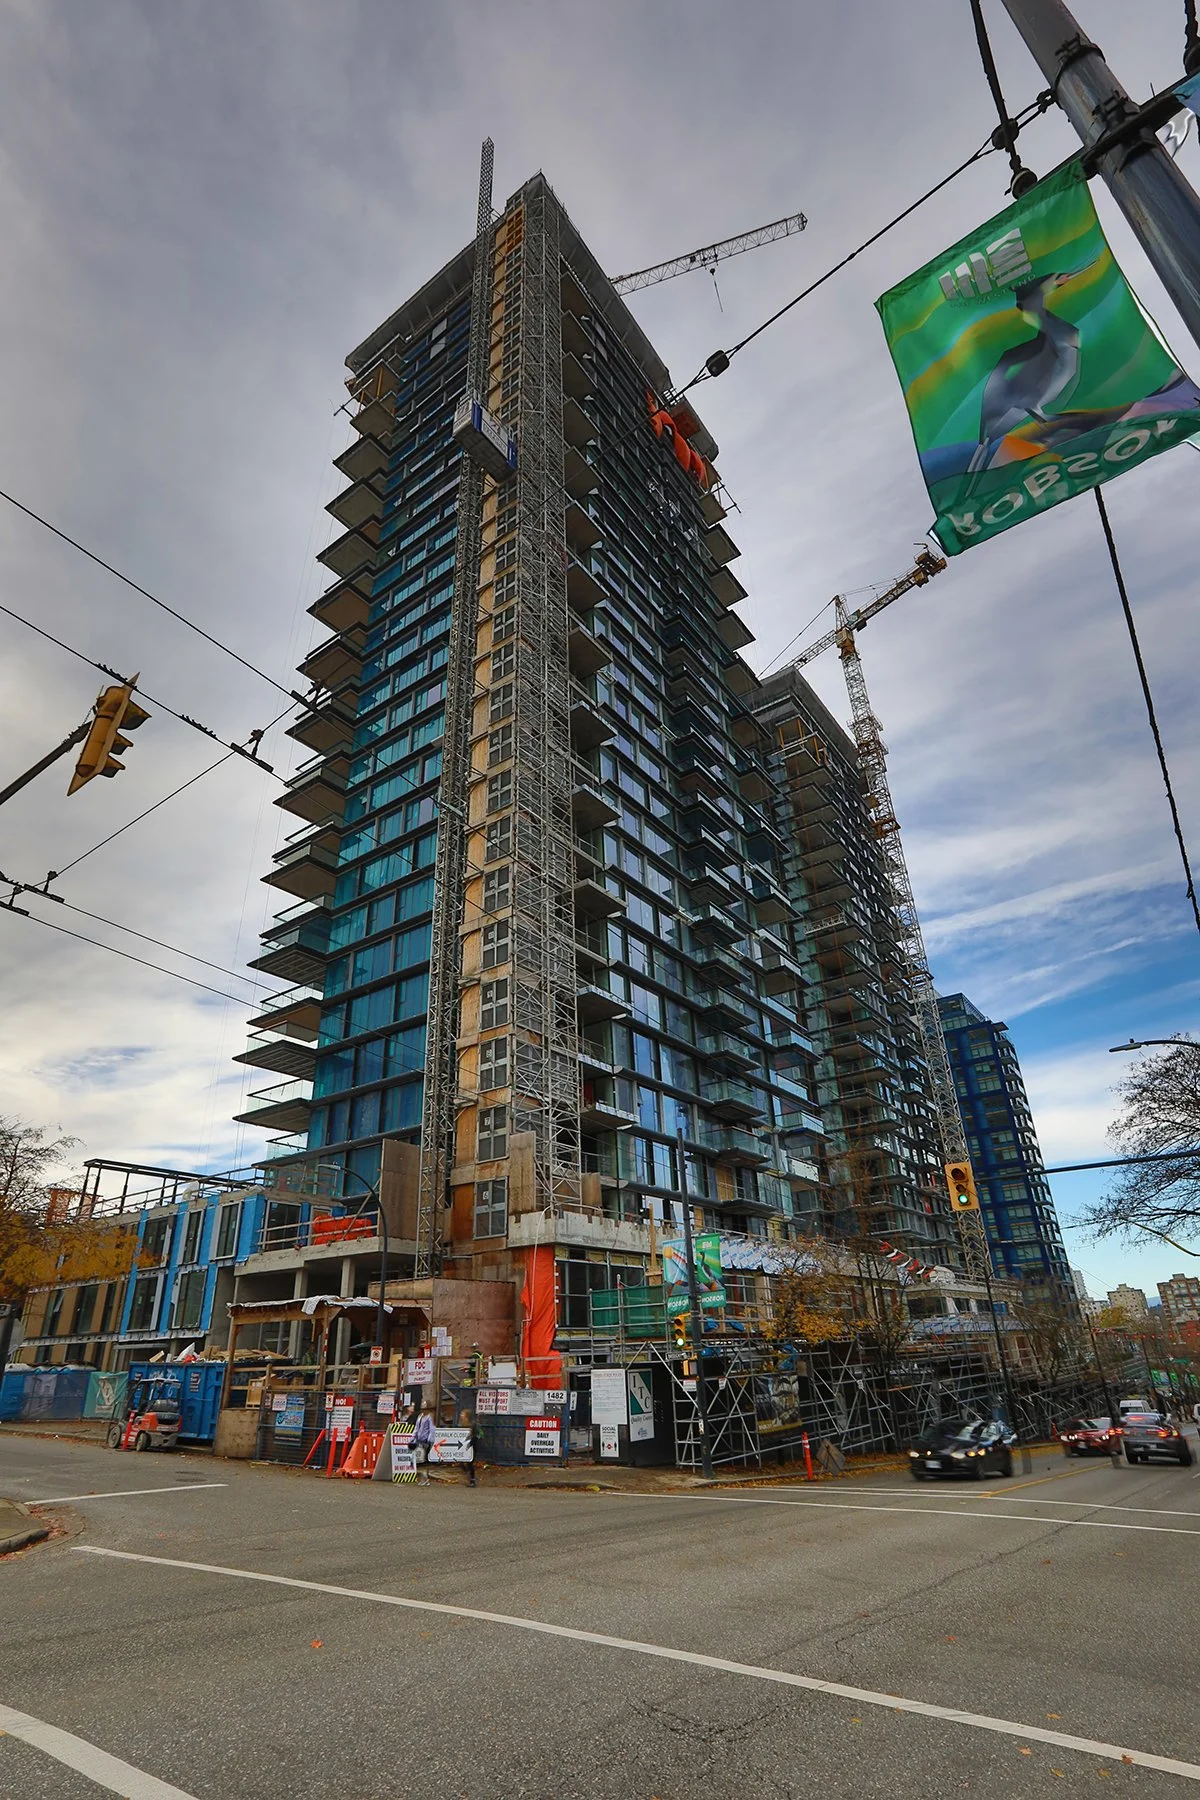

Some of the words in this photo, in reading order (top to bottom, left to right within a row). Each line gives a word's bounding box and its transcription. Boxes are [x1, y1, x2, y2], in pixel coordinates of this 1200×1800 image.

[414, 1361, 426, 1370] FDC
[632, 1375, 651, 1410] ITC
[530, 1420, 557, 1428] CAUTION
